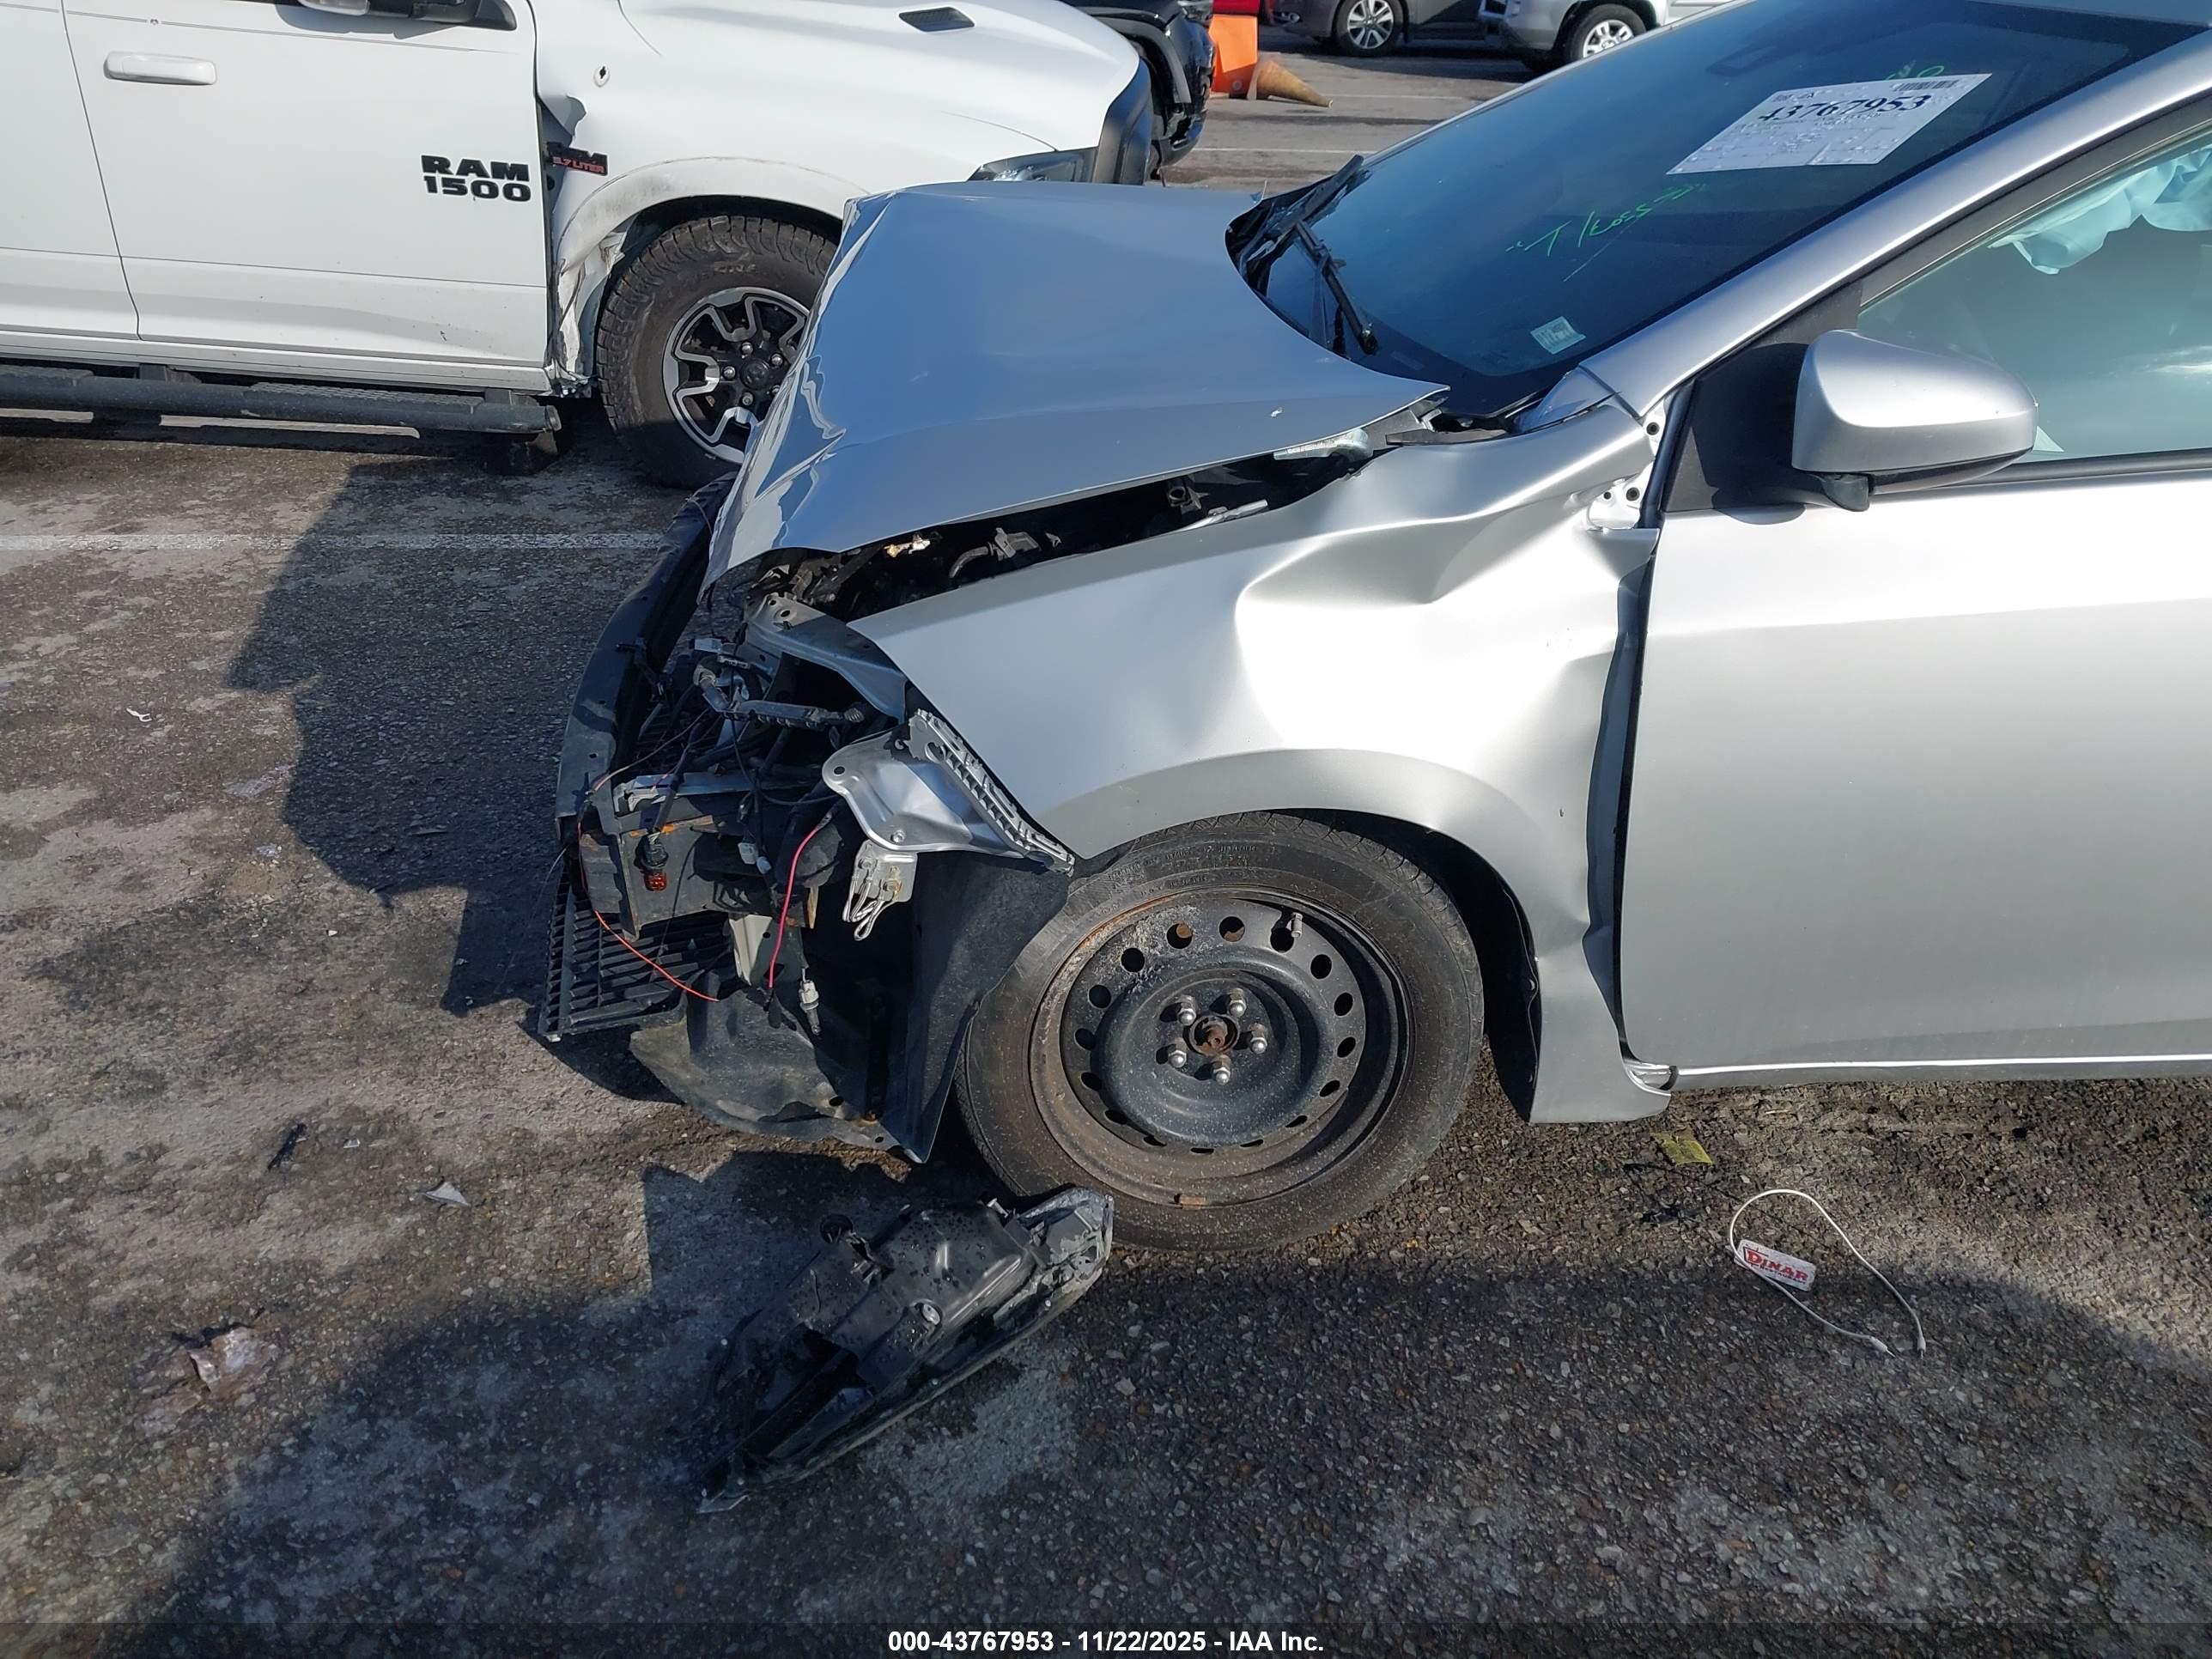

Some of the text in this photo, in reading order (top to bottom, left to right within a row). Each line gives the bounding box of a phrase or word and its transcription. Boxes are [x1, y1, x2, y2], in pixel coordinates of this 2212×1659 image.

[1759, 94, 1931, 122] 43767953
[421, 155, 530, 182] RAM
[423, 175, 532, 202] 1500
[1747, 1249, 1808, 1281] DINAR
